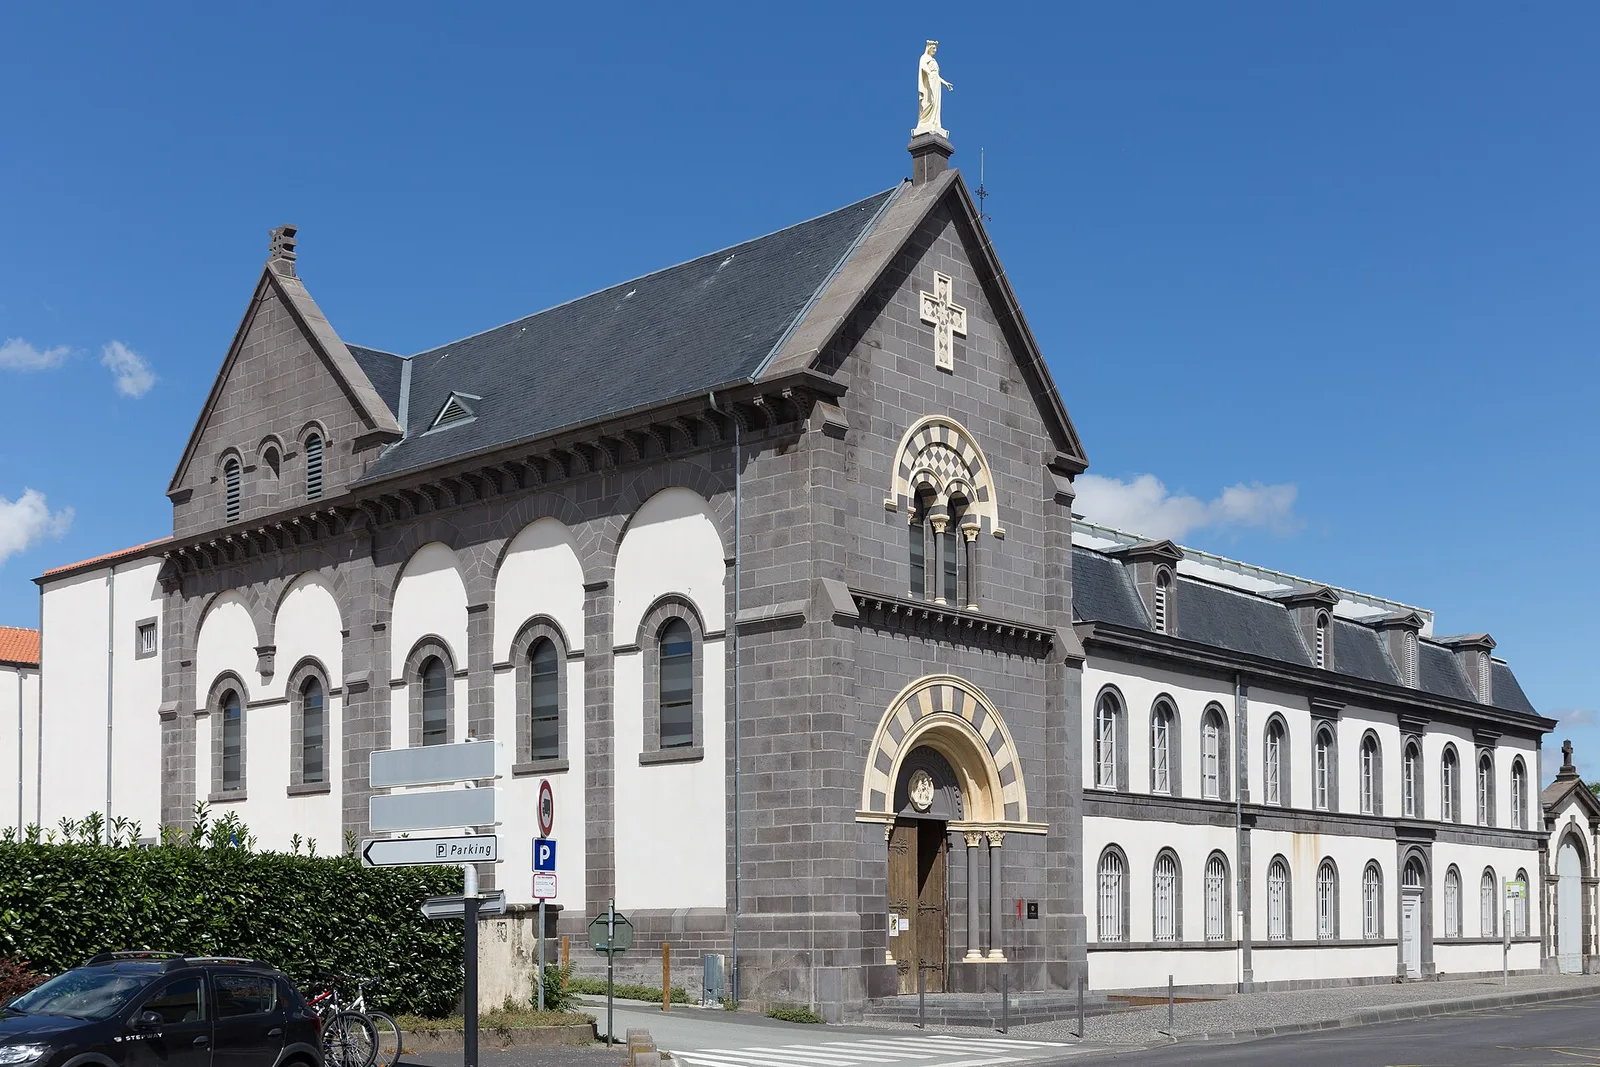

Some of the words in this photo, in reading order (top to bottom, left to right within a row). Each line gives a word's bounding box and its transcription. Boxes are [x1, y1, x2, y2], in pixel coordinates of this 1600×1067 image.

[438, 846, 445, 856] P
[450, 843, 491, 856] Parking
[539, 844, 551, 866] P
[125, 1032, 163, 1041] STEPWAY
